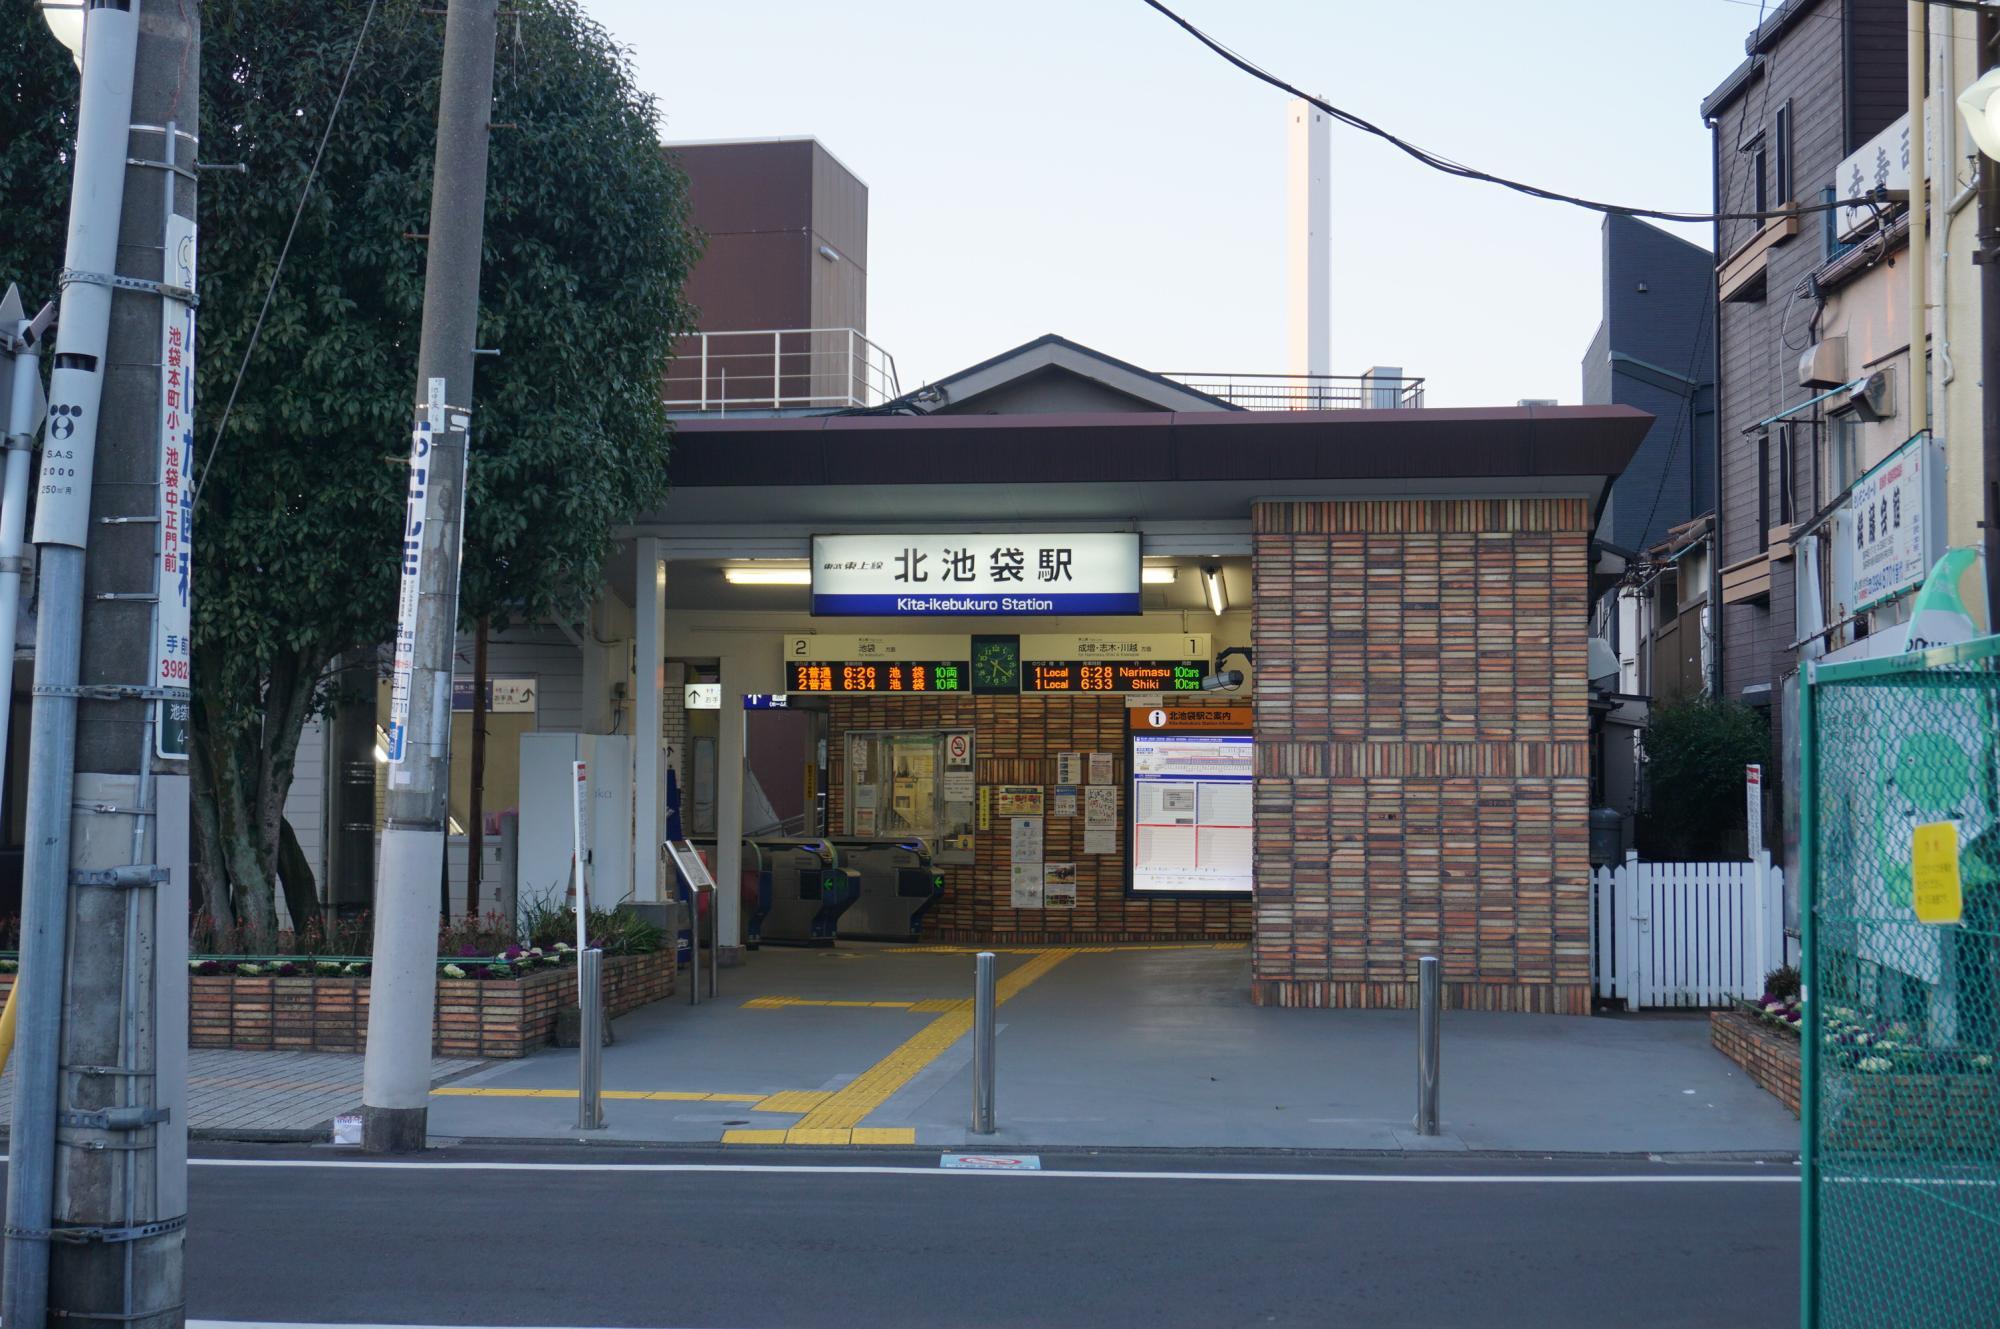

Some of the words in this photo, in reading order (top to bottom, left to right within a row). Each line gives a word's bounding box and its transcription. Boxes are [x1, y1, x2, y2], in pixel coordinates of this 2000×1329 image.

[47, 450, 73, 459] S.A.S
[43, 467, 75, 477] 2000
[894, 547, 1073, 583] 北池袋駅
[897, 597, 998, 611] Kita-ikebukuro
[1001, 597, 1053, 611] Station
[795, 640, 807, 655] 2
[1190, 639, 1196, 654] 1
[798, 667, 807, 678] 2
[809, 666, 832, 678] 普通
[843, 667, 876, 678] 6:26
[934, 667, 958, 678] 10両
[1035, 667, 1041, 678] 1
[1043, 668, 1069, 678] Local
[1081, 667, 1113, 678] 6:28
[1119, 667, 1171, 678] Narimasu
[798, 679, 807, 690] 2
[809, 678, 833, 690] 普通
[843, 679, 876, 690] 6:34
[935, 679, 958, 690] 10両
[1035, 679, 1041, 690] 1
[1043, 679, 1069, 689] Local
[1081, 679, 1113, 690] 6:33
[1131, 679, 1159, 689] Shiki
[1169, 711, 1232, 721] 北池袋駅ご案内
